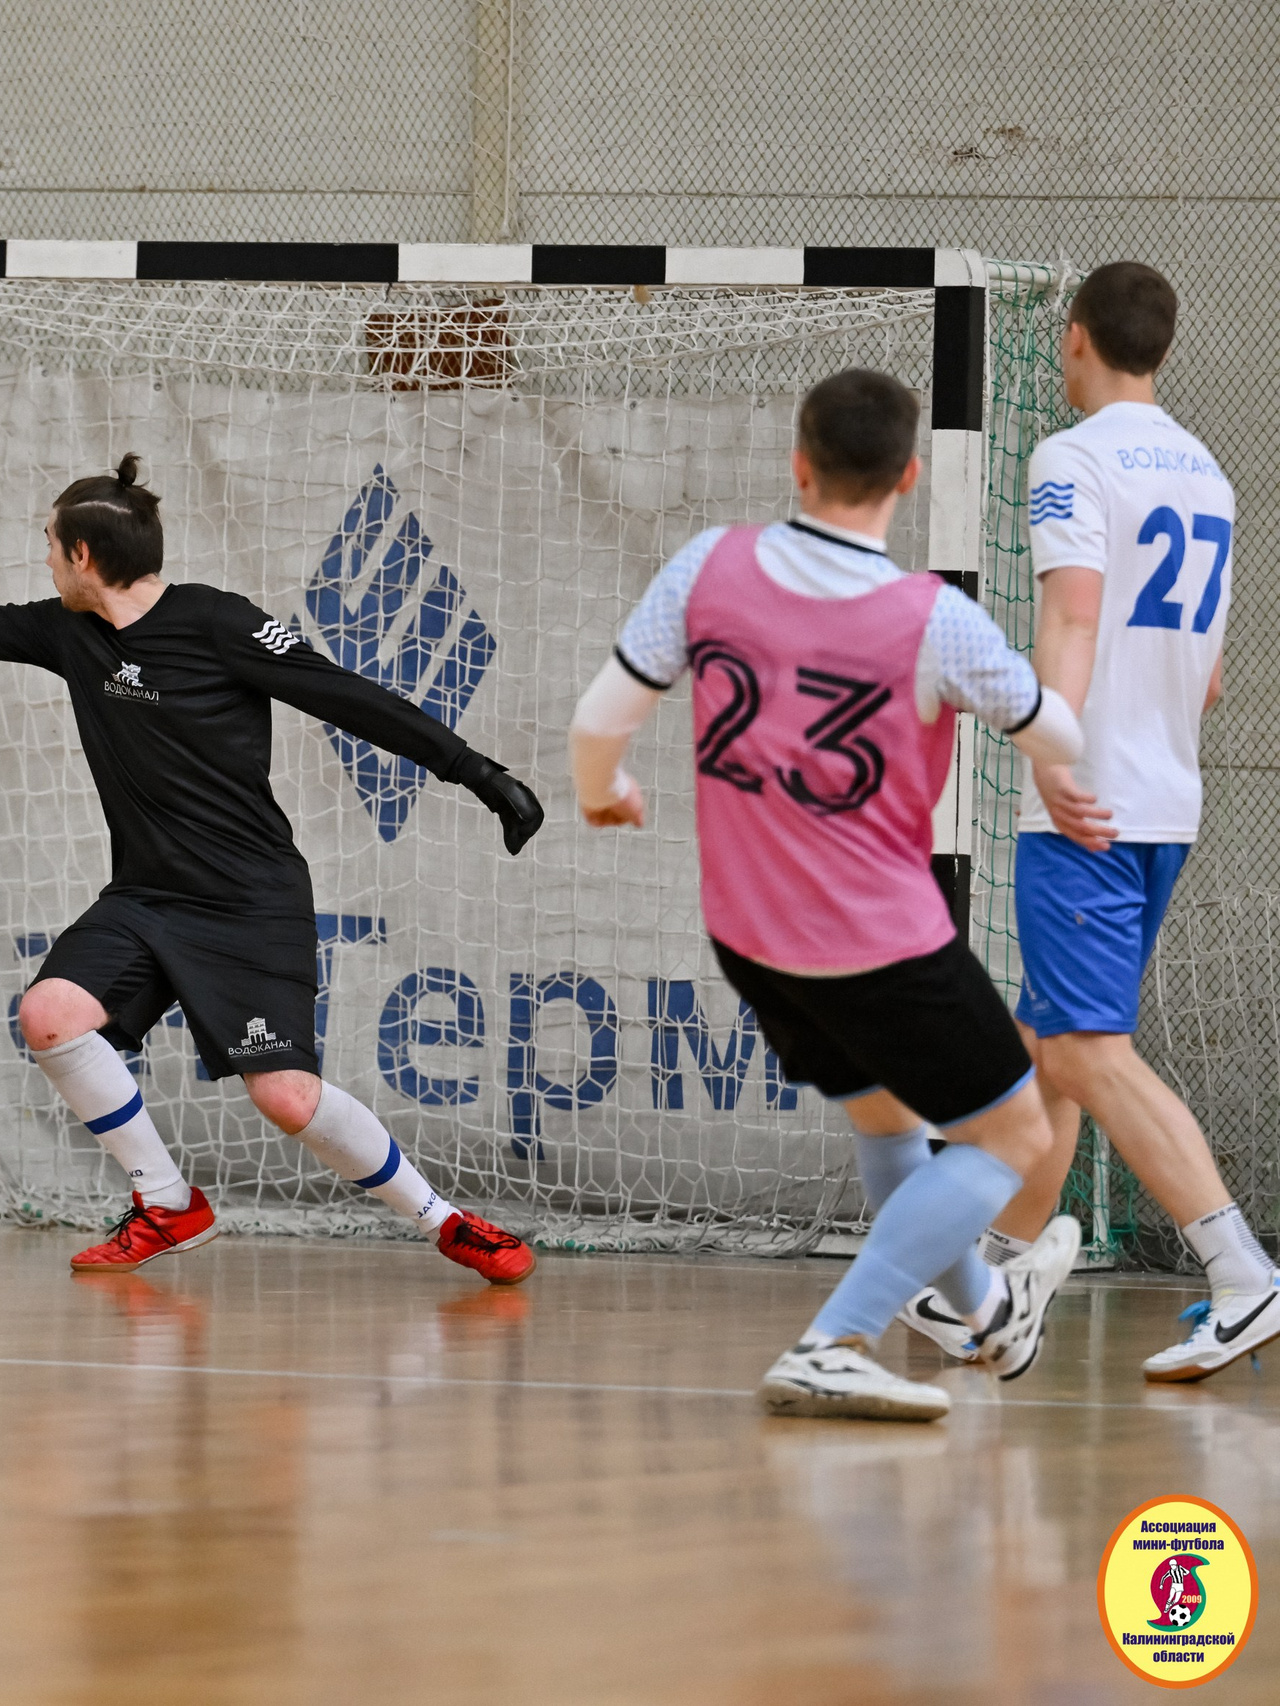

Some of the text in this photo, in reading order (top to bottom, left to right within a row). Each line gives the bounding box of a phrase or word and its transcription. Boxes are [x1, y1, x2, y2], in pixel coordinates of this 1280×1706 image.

[1126, 505, 1232, 635] 27
[104, 680, 159, 701] ВОДОКАНАЛ
[688, 639, 893, 817] 23
[228, 1039, 292, 1055] ВОДОКАНАЛ
[417, 1192, 437, 1218] JAKO
